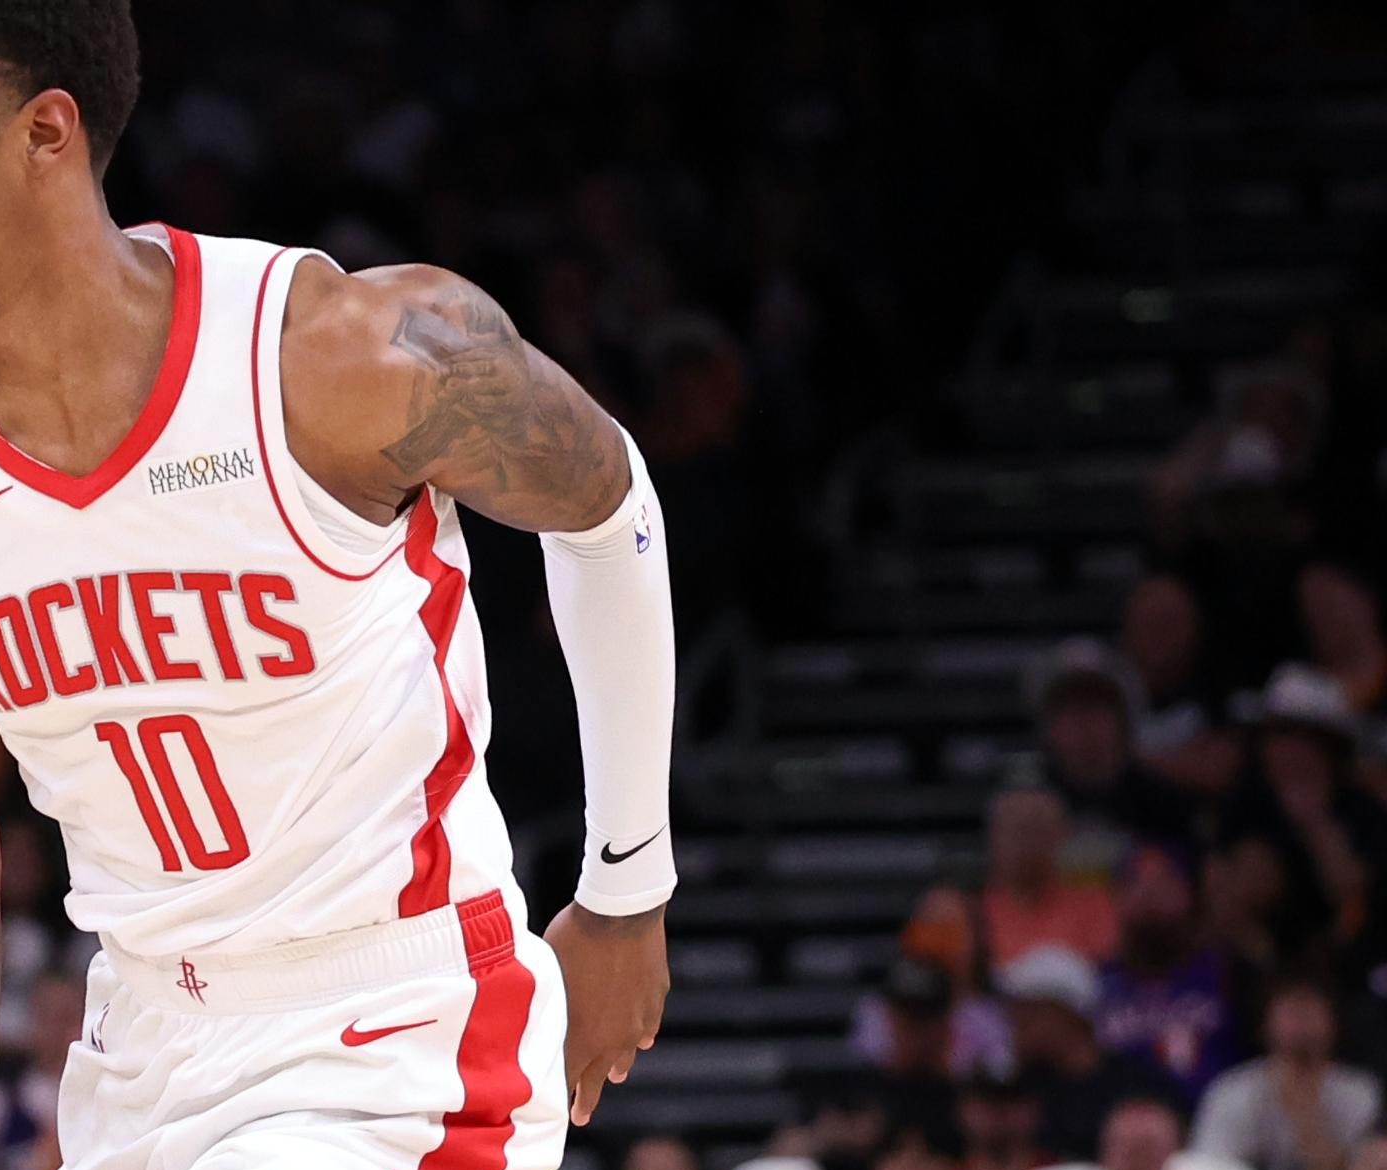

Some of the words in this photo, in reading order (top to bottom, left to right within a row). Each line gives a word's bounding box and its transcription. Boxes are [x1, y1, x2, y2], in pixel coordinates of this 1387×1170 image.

[148, 447, 254, 480] MEMORIAL
[149, 460, 255, 495] HERMANN
[94, 714, 251, 872] 10
